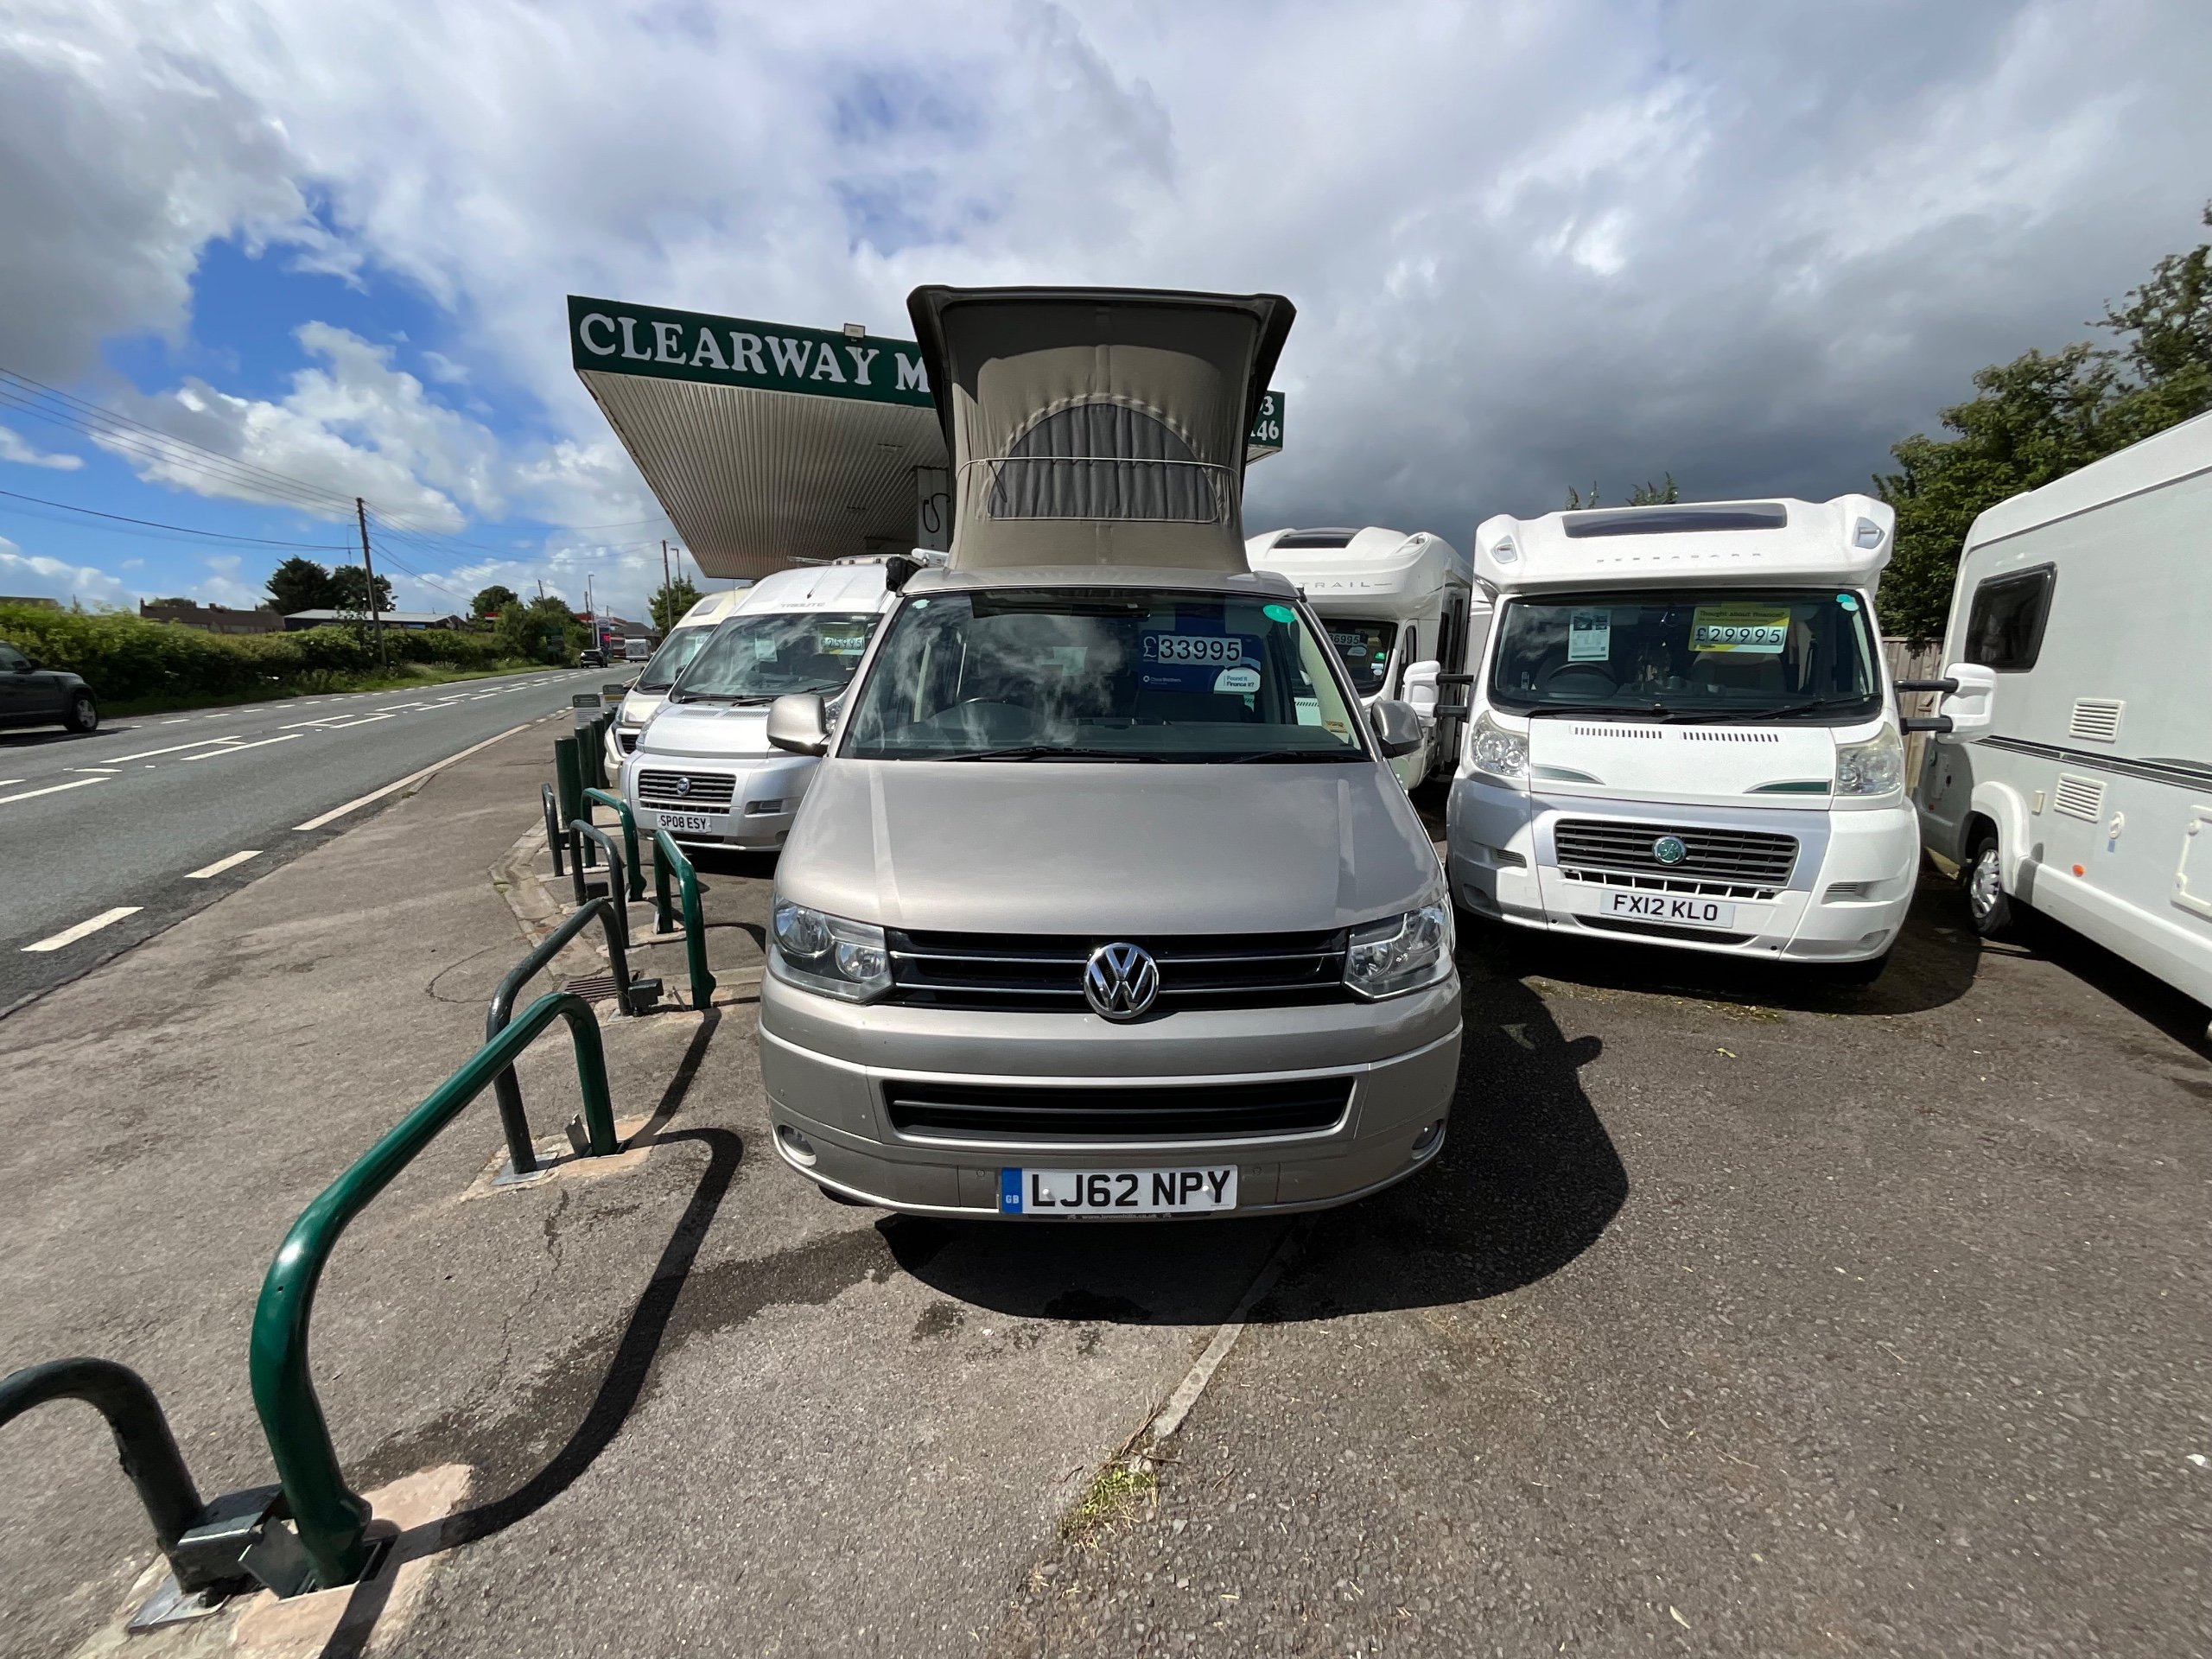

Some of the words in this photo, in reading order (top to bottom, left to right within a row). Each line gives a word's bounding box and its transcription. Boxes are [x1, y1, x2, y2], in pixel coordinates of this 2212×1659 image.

[580, 313, 880, 385] CLEARWAY
[1260, 396, 1274, 416] 3
[1695, 627, 1781, 643] £29995
[1143, 636, 1240, 661] £33995
[660, 815, 684, 828] SP08
[687, 817, 706, 830] ESY
[1613, 894, 1663, 916] FX12
[1671, 900, 1718, 921] KLO
[1005, 1194, 1020, 1204] GB
[1032, 1174, 1139, 1207] LJ62
[1153, 1170, 1230, 1205] NPY
